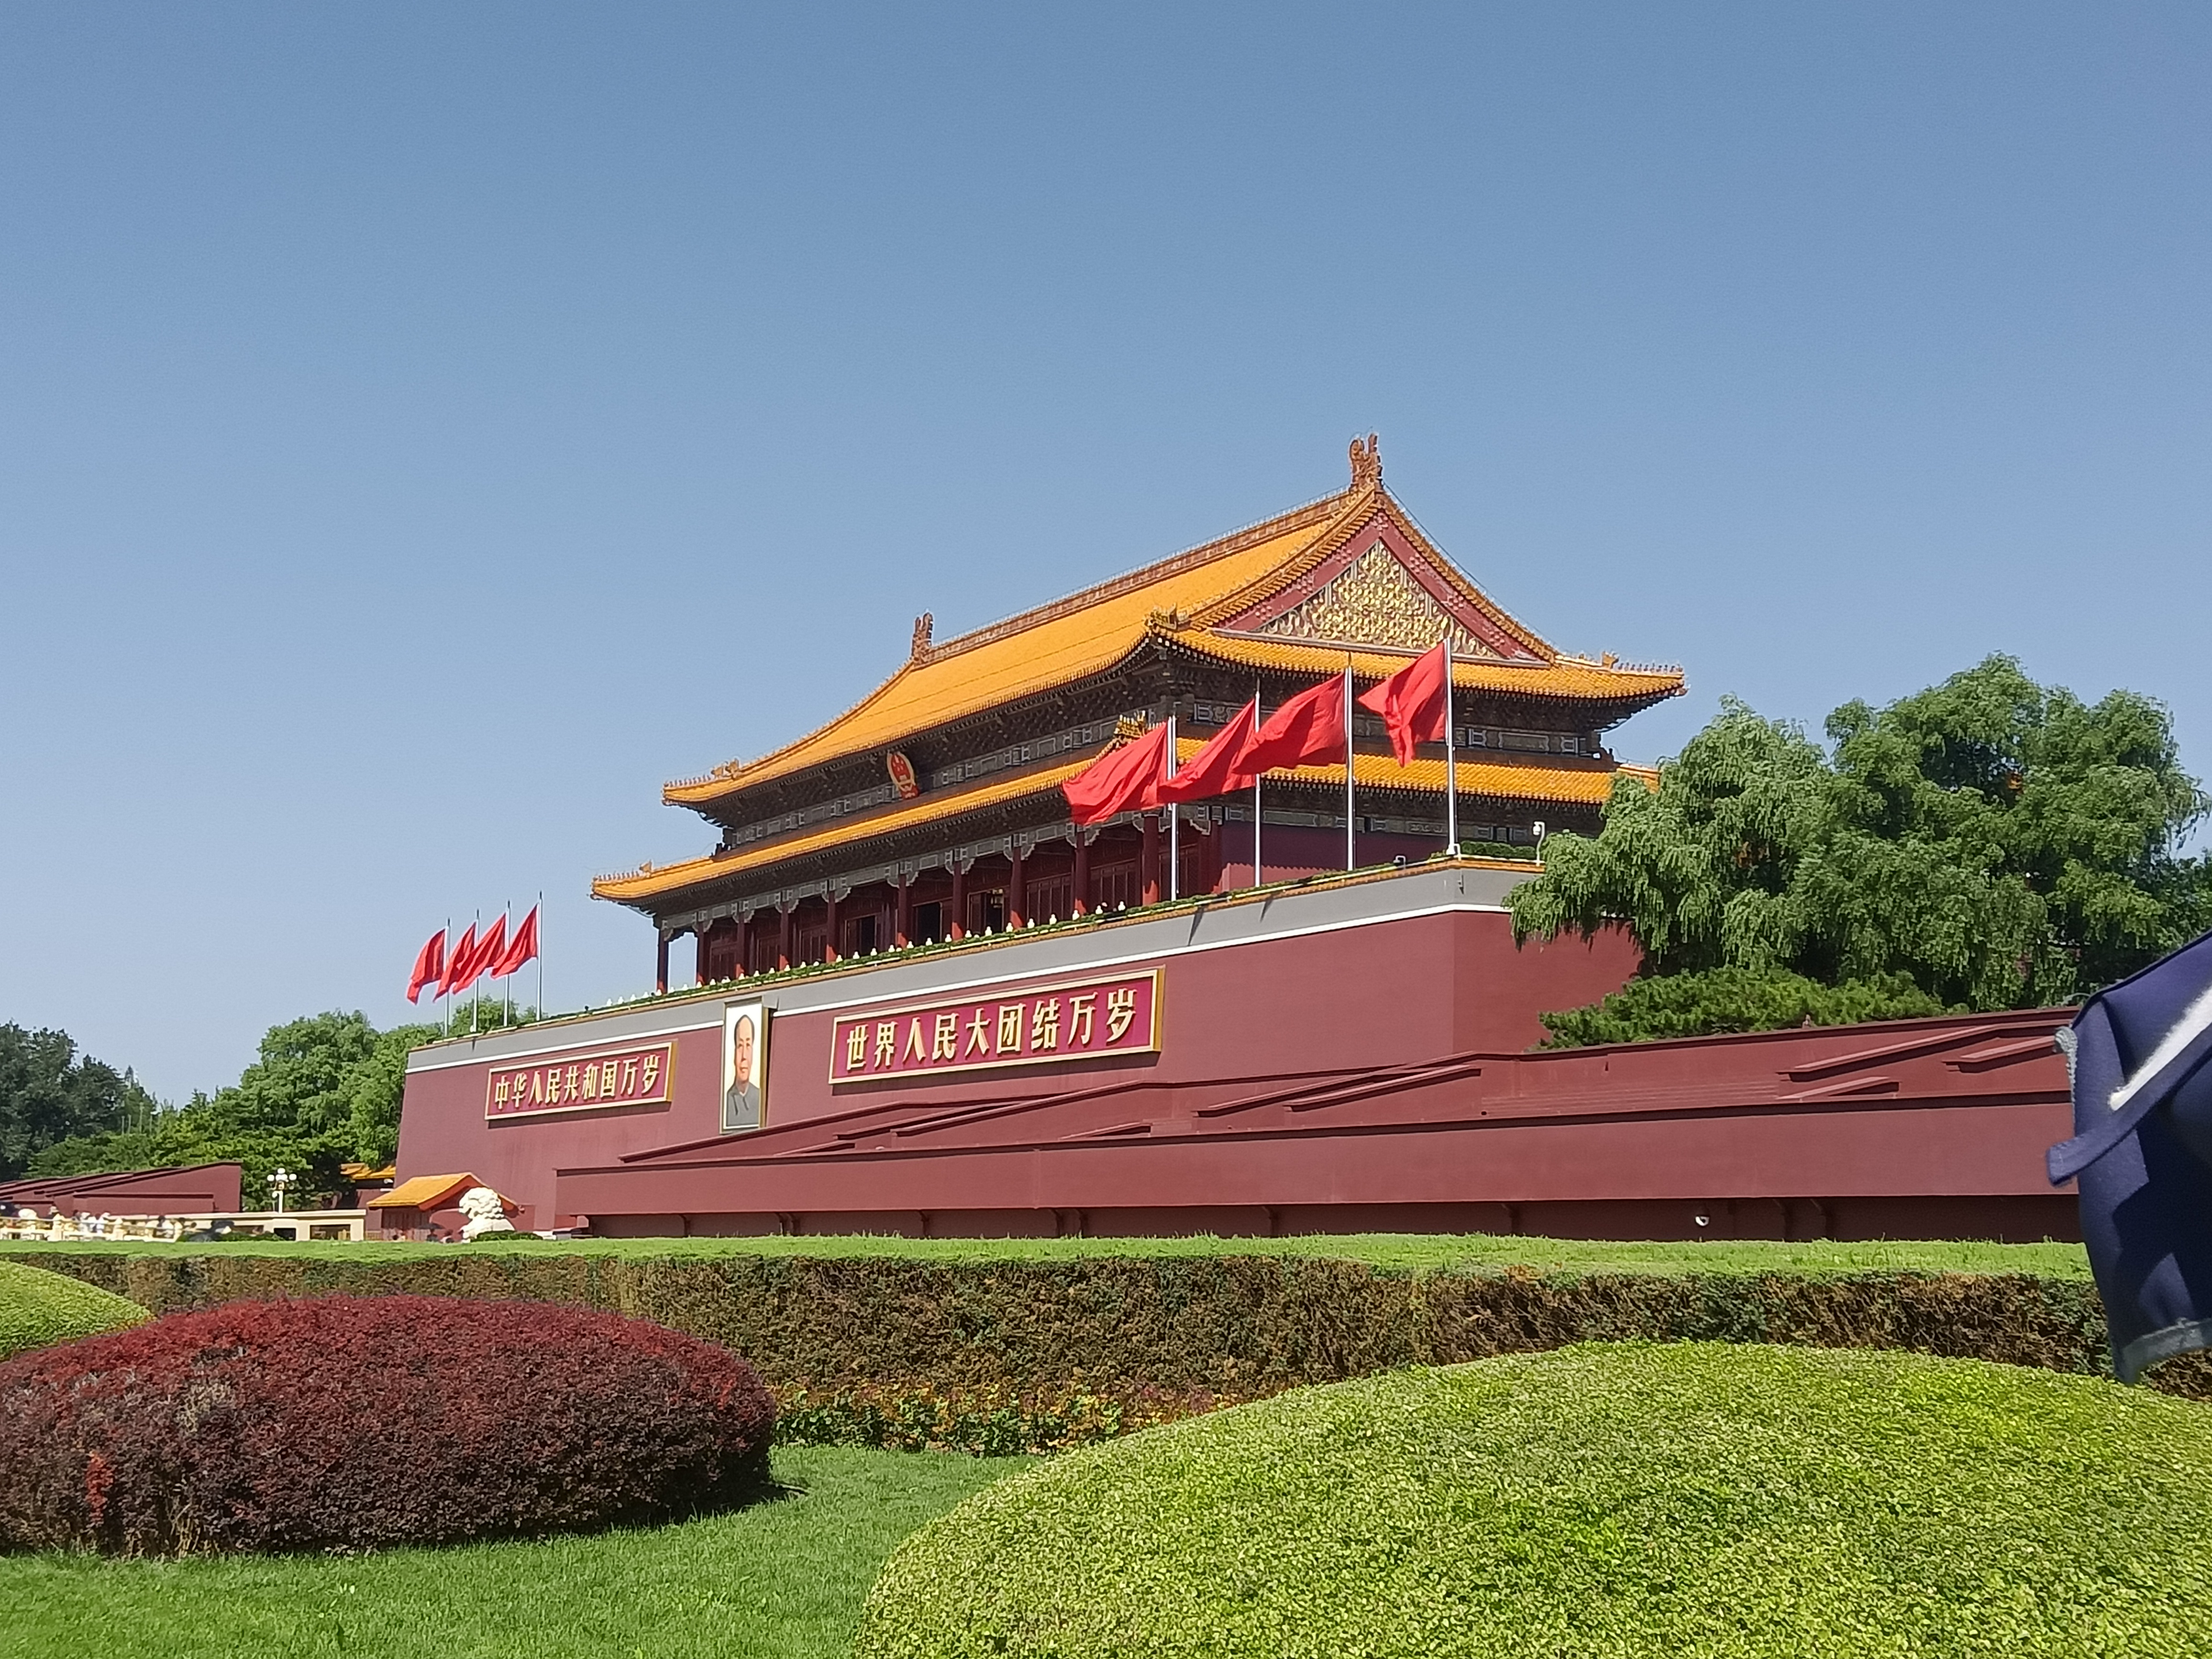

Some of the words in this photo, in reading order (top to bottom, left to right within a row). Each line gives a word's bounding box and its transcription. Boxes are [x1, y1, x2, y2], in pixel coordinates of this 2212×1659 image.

[846, 988, 1137, 1070] 世界人民大团结万岁
[495, 1054, 661, 1110] 中华人民共和国万岁
